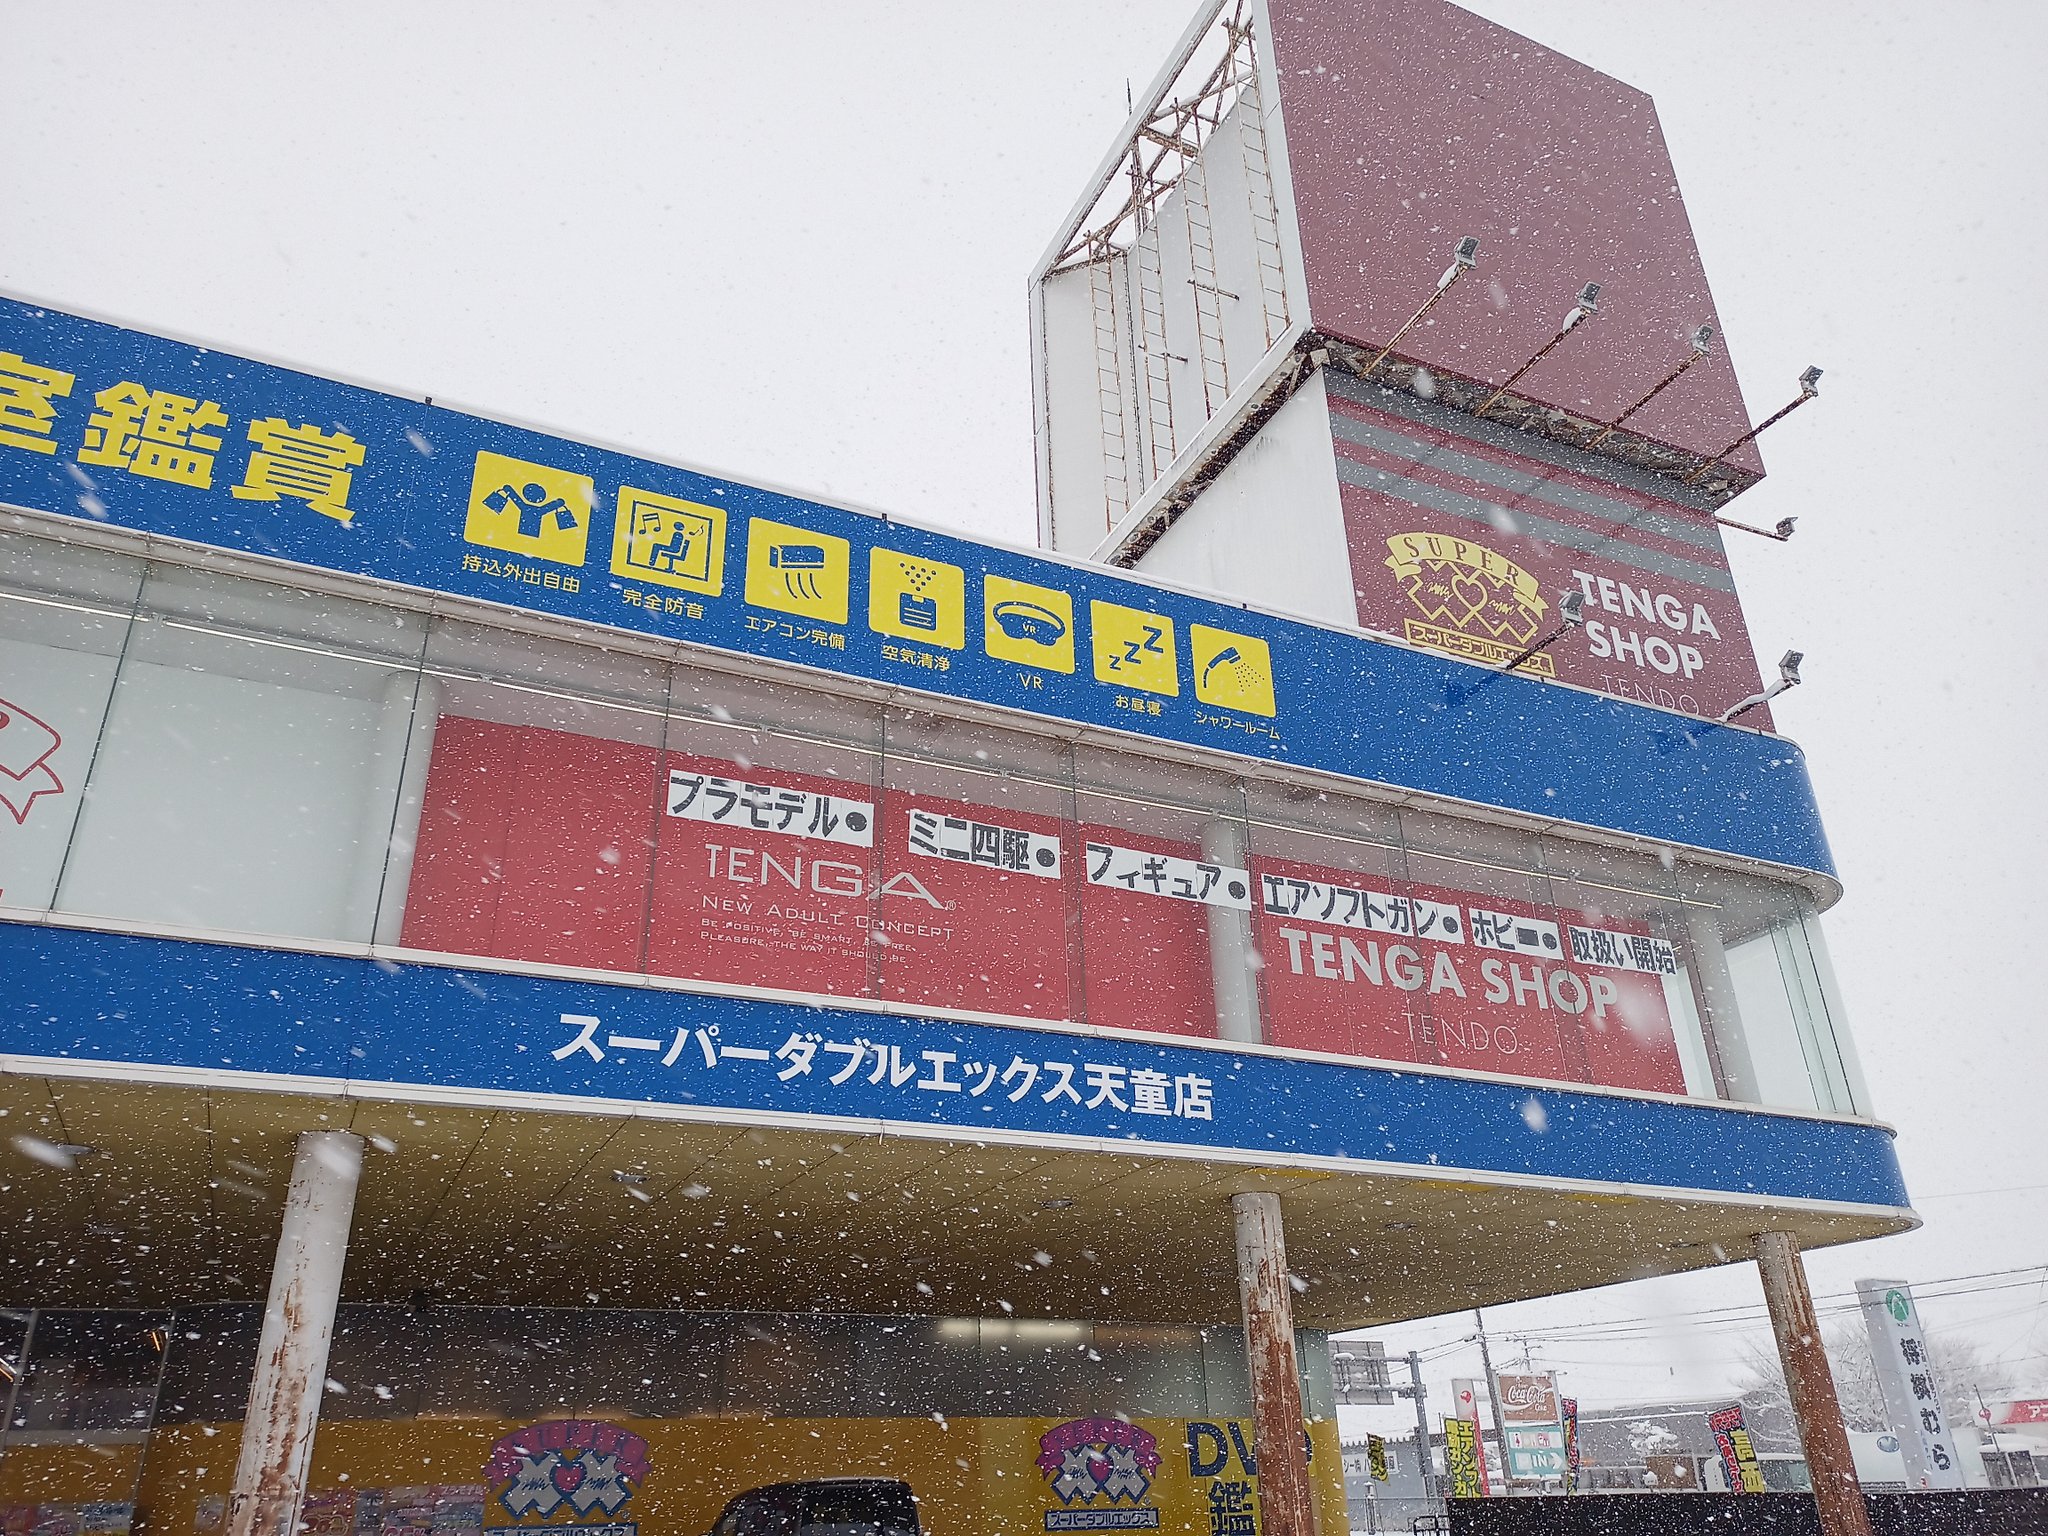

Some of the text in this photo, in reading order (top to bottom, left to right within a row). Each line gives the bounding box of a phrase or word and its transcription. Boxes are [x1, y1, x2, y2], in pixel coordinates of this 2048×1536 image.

[462, 552, 581, 595] 持込外出自由
[1402, 535, 1521, 588] SUPER
[622, 587, 705, 621] 完全防音
[1571, 569, 1722, 641] TENGA
[744, 615, 846, 652] エアコン完備
[1585, 621, 1704, 680] SHOP
[881, 644, 951, 672] 空気清浄
[1019, 672, 1043, 691] VR
[1601, 674, 1700, 716] TENDO
[1115, 694, 1162, 718] お昼寝
[1195, 711, 1282, 741] シャワールーム
[704, 843, 947, 910] TENGA
[701, 918, 718, 928] BE
[702, 895, 955, 941] NEW ADULT CONCEPT
[774, 940, 797, 951] THE
[801, 943, 824, 954] WAY
[827, 946, 838, 956] IT
[1569, 925, 1677, 976] 取扱い開始
[1279, 928, 1619, 1019] TENGA SHOP
[1401, 1012, 1520, 1055] TENDO
[551, 1013, 1214, 1121] スーパーダブルエックス天童店
[1187, 1421, 1312, 1477] DV
[1532, 1453, 1549, 1468] IN
[1051, 1512, 1151, 1527] スーパーダブルエックス
